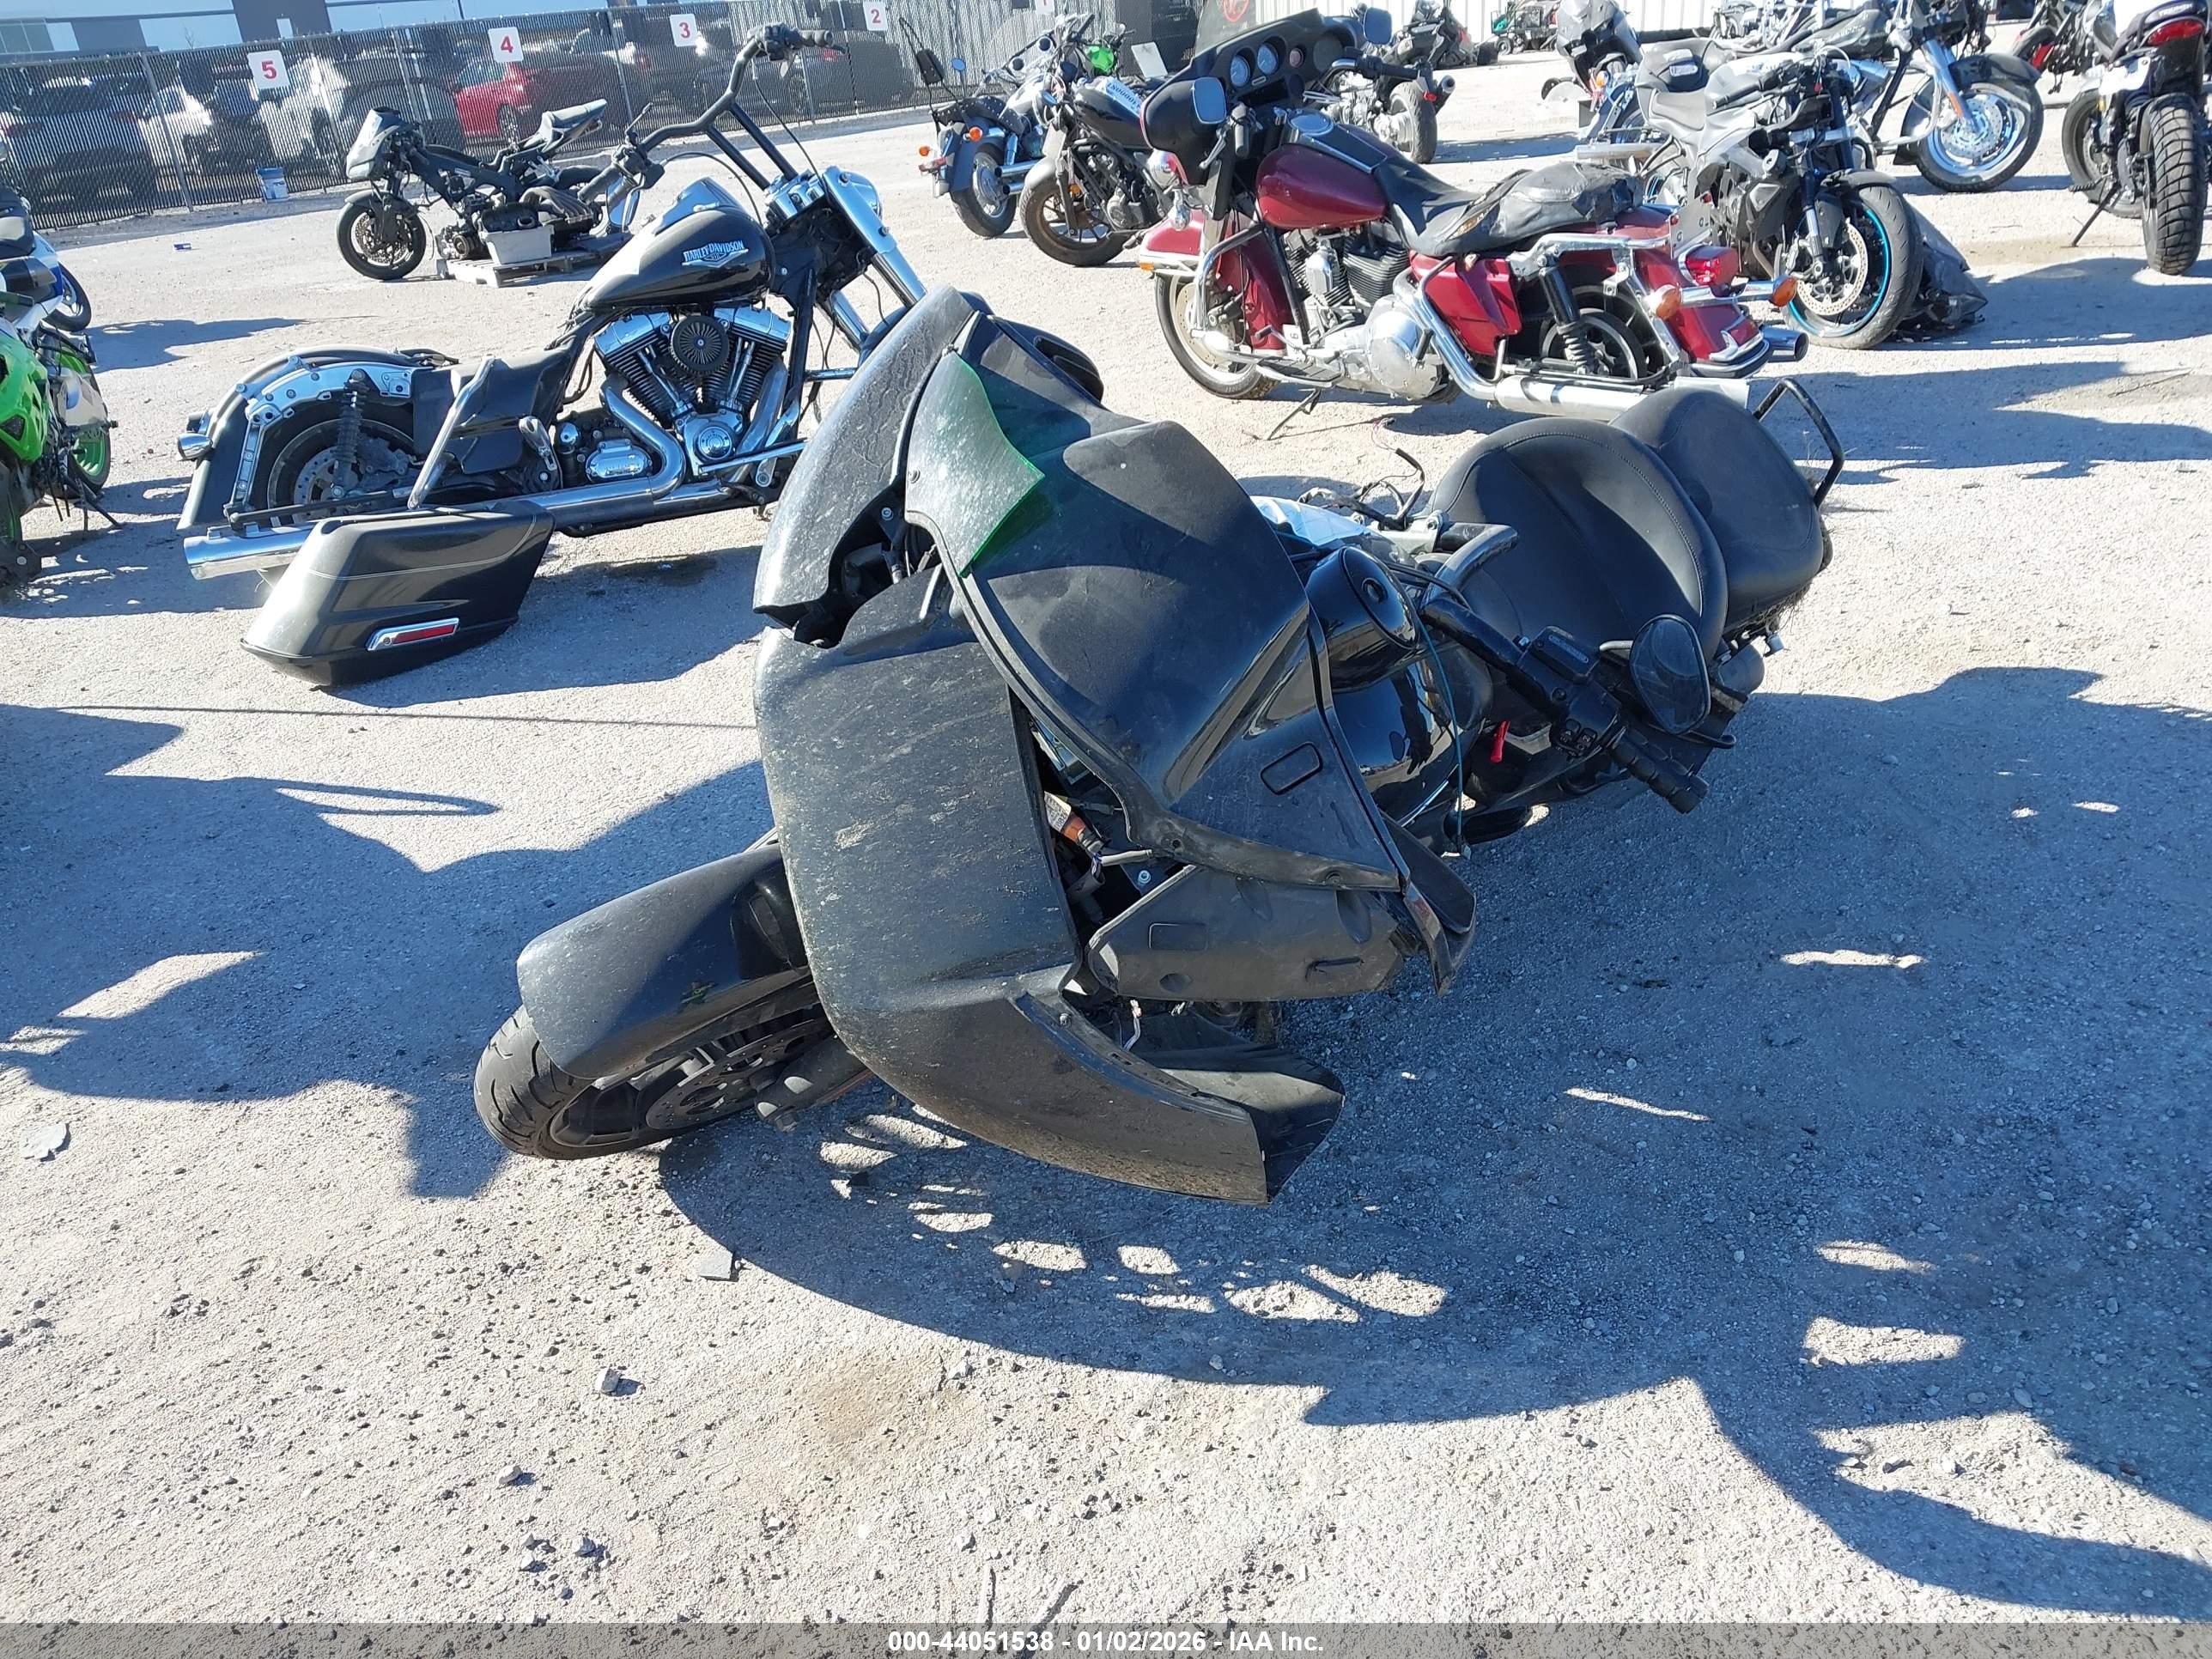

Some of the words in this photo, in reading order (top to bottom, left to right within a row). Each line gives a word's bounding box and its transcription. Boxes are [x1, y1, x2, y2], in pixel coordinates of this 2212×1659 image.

[871, 9, 881, 23] 2
[679, 21, 690, 38] 3
[501, 35, 514, 52] 4
[261, 60, 276, 79] 5
